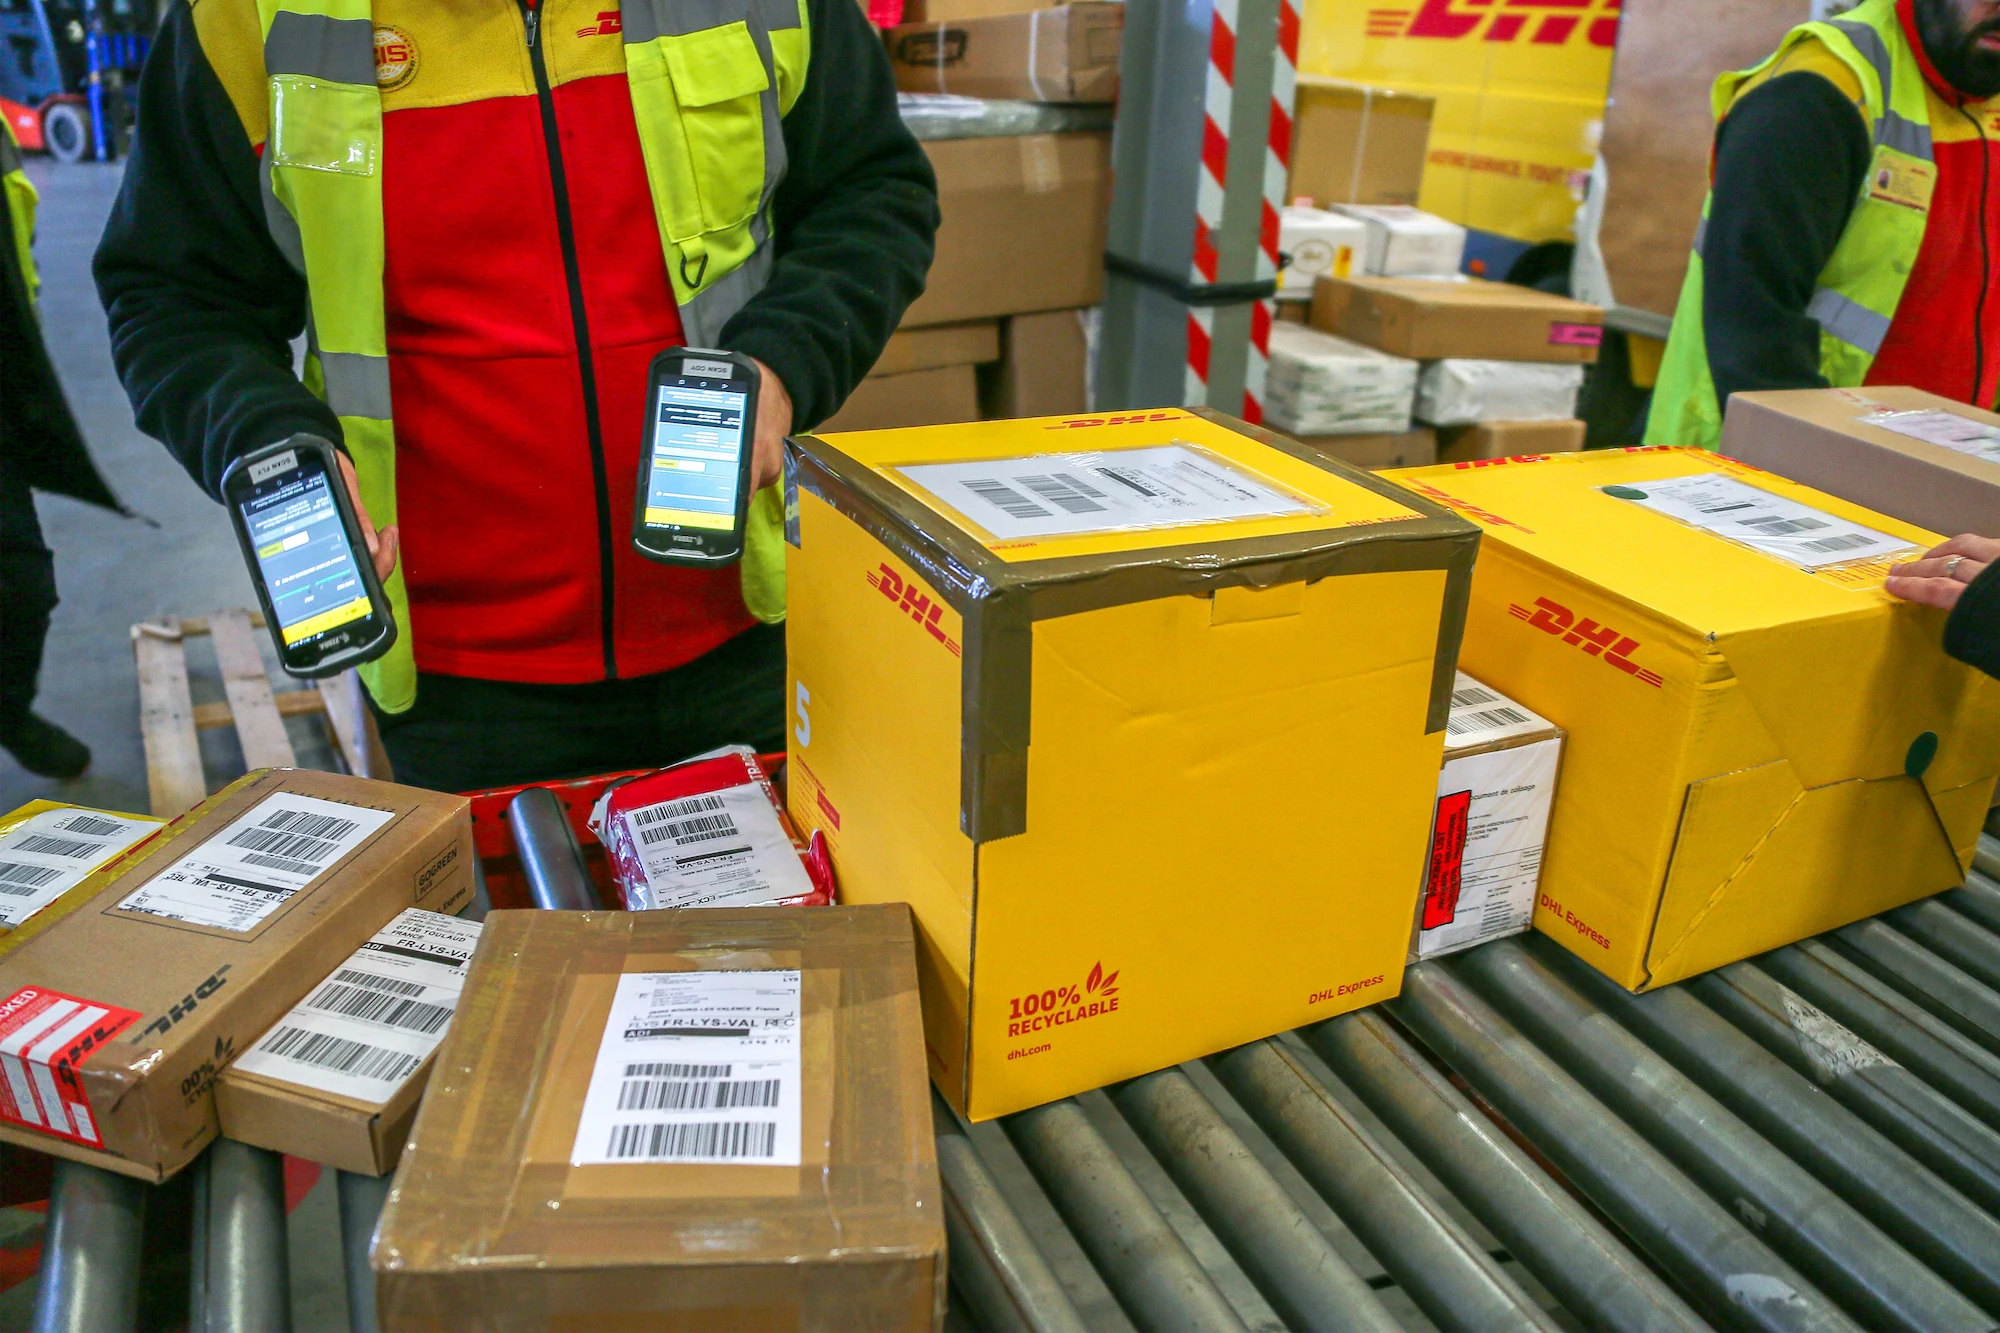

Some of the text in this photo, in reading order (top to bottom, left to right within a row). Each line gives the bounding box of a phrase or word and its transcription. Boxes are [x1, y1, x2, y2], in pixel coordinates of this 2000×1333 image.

[1062, 413, 1182, 428] DHL
[271, 456, 291, 470] SCAN
[876, 562, 948, 645] DHL
[1526, 596, 1642, 677] DHL
[795, 680, 811, 749] 5
[1471, 791, 1499, 801] ocument
[53, 815, 75, 829] DHL
[419, 847, 458, 887] GOGREEN
[1429, 831, 1445, 898] PACKING LIST
[164, 872, 188, 881] REC
[187, 877, 260, 895] FR-LYS-VAL
[696, 894, 715, 904] ECX
[1540, 893, 1564, 920] DHL
[1565, 912, 1611, 950] Express
[390, 929, 425, 940] FRANCE
[422, 929, 466, 943] TOULAUD
[1308, 974, 1384, 1005] DHL Express
[0, 990, 38, 1019] CKED
[143, 973, 228, 1037] DHL
[1008, 984, 1081, 1020] 100%
[662, 1018, 758, 1026] FR-LYS-VAL
[764, 1018, 795, 1026] REC
[1008, 997, 1119, 1038] RECYCLABLE
[1007, 1043, 1051, 1061] dhl.com
